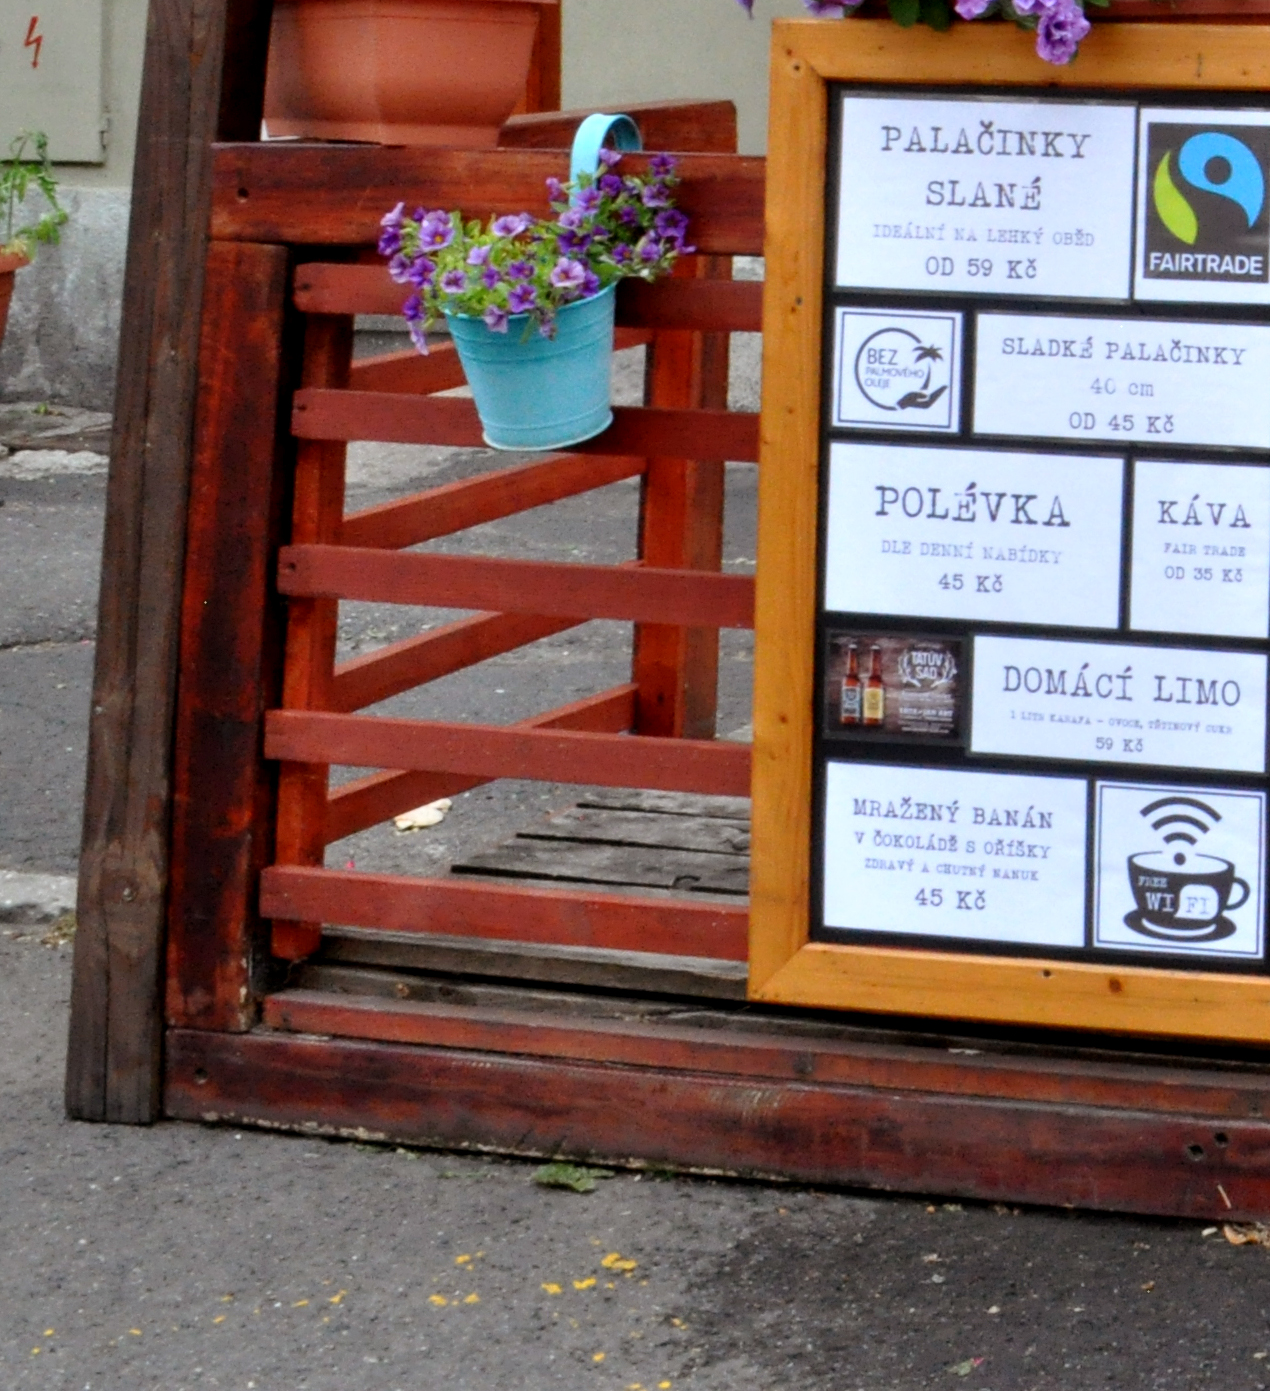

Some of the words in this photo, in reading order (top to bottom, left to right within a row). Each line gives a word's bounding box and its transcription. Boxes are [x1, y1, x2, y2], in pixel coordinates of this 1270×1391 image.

[880, 120, 1091, 160] PALAČINKY
[925, 177, 1042, 210] SLANÉ
[873, 223, 945, 242] IDEÁLNÍ
[954, 226, 977, 242] NA
[986, 227, 1043, 245] LEHKÝ
[1053, 228, 1094, 247] OBĚD
[925, 257, 954, 276] OD
[967, 259, 993, 278] 59
[1007, 259, 1037, 279] Kč
[1149, 253, 1262, 276] FAIRTRADE
[867, 348, 898, 367] BEZ
[1002, 337, 1094, 360] SLADKÉ
[1106, 338, 1246, 366] PALAČINKY
[865, 365, 925, 380] PALMOVÉHO
[865, 378, 890, 389] OLEJE
[1090, 378, 1116, 395] 40
[1129, 382, 1154, 397] cm
[1069, 412, 1096, 431] OD
[1108, 415, 1135, 432] 45
[1147, 413, 1174, 434] Kč
[875, 483, 1071, 528] POLÉVKA
[1157, 495, 1251, 529] KÁVA
[881, 540, 912, 556] DLE
[920, 542, 973, 560] DENNÍ
[983, 545, 1063, 566] NABÍDKY
[1163, 542, 1198, 556] FAIR
[1205, 544, 1246, 558] TRADE
[938, 574, 964, 591] 45
[976, 575, 1003, 594] Kč
[1164, 566, 1185, 580] OD
[1193, 566, 1213, 582] 35
[1222, 567, 1243, 583] Kč
[1002, 662, 1133, 702] DOMÁCÍ
[1153, 676, 1241, 707] LIMO
[1095, 736, 1113, 751] 59
[1123, 737, 1144, 753] Kč
[853, 798, 961, 824] MRAŽENÝ
[972, 804, 1053, 830] BANÁN
[873, 830, 958, 853] ČOKOLÁDĚ
[966, 839, 976, 853] S
[984, 838, 1051, 861] OŘÍŠKY
[865, 857, 914, 872] ZDRAVÝ
[921, 862, 931, 873] A
[936, 861, 986, 879] CHUTNÝ
[992, 866, 1038, 881] NANUK
[1138, 875, 1168, 889] FREE
[915, 889, 943, 908] 45
[956, 890, 986, 911] Kč
[1145, 892, 1174, 912] WI
